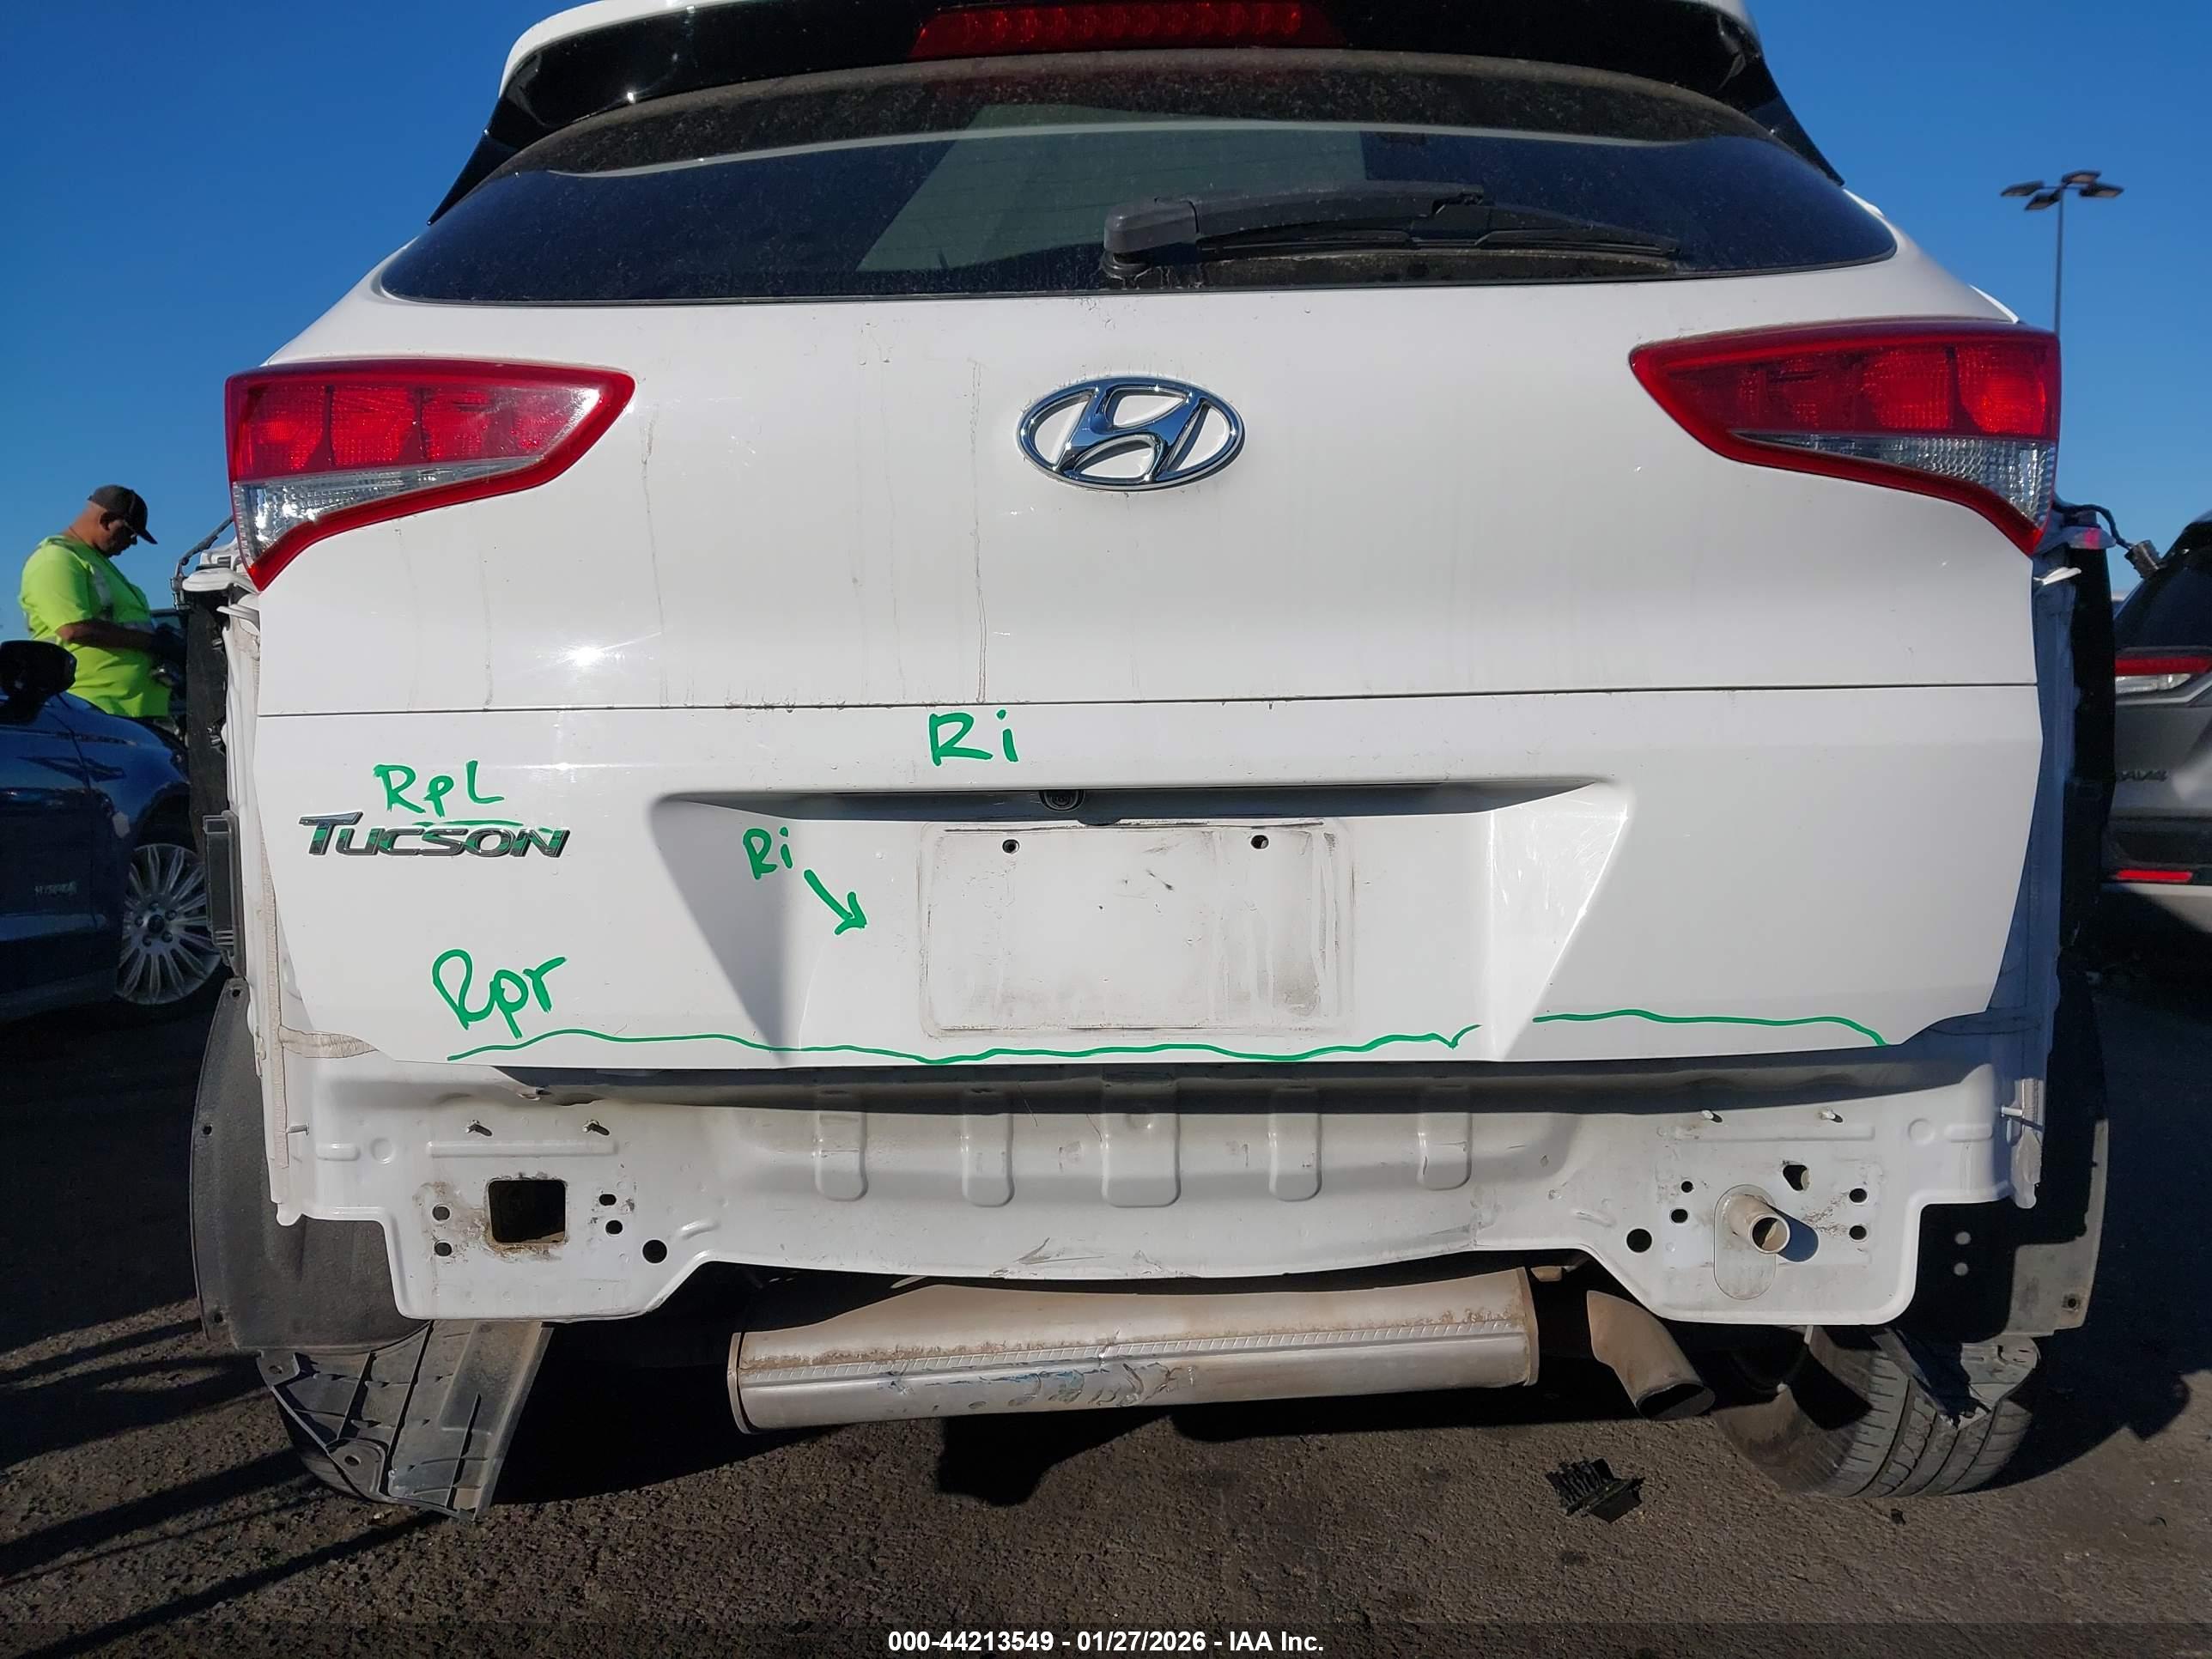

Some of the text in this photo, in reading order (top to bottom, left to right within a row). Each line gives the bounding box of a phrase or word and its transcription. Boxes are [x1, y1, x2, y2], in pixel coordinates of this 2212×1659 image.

[928, 709, 1019, 767] Ri
[299, 811, 570, 858] TUCSON
[743, 827, 793, 879] Ri
[432, 949, 567, 1039] Rpr
